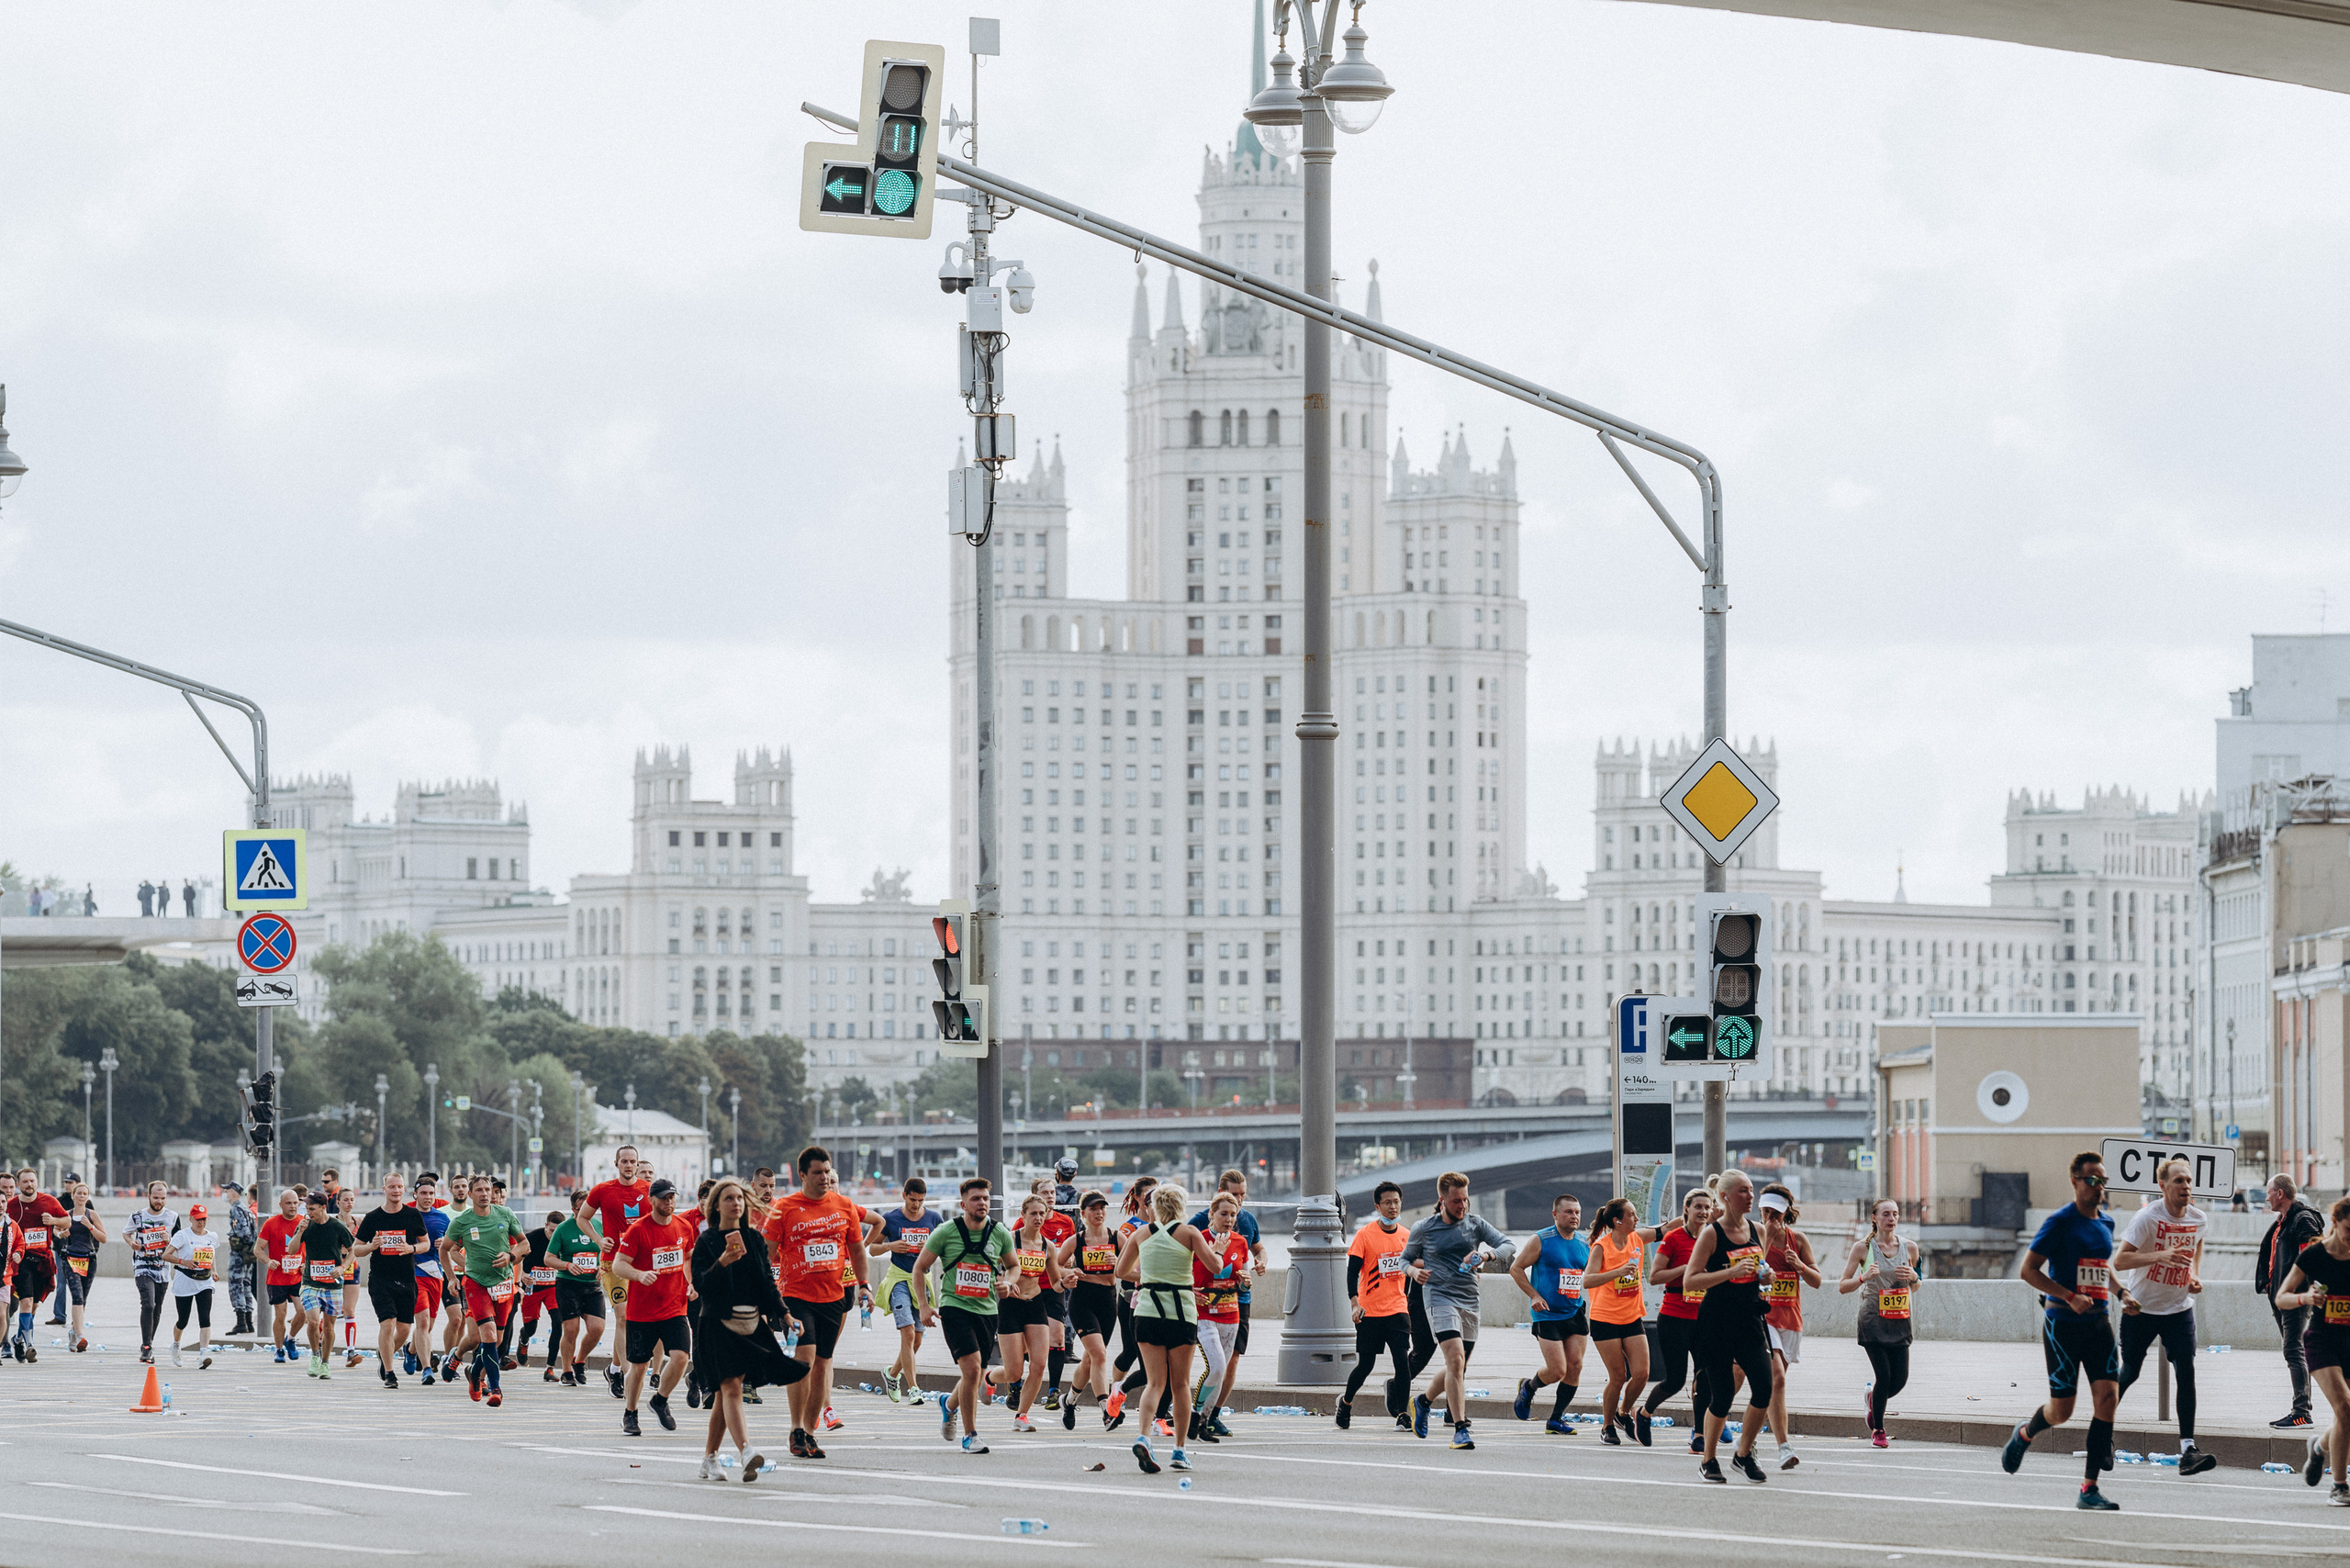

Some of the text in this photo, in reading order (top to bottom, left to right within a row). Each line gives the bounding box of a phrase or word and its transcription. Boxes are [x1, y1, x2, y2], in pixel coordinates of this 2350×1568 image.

[893, 123, 917, 154] 11
[1633, 1075, 1649, 1084] 140
[2121, 1148, 2216, 1189] СТП
[28, 1232, 45, 1240] 6682
[383, 1237, 403, 1245] 5288
[903, 1234, 928, 1242] 10870
[195, 1252, 214, 1260] 11743
[809, 1244, 834, 1257] 5843
[1087, 1251, 1105, 1261] 997
[577, 1258, 594, 1266] 3014
[657, 1251, 679, 1264] 2881
[1018, 1256, 1045, 1268] 10220
[1382, 1258, 1400, 1269] 924
[312, 1266, 334, 1274] 1035
[533, 1271, 554, 1279] 10351
[2146, 1263, 2165, 1282] НЕ
[958, 1271, 990, 1283] 10803
[490, 1282, 512, 1294] 13278
[1772, 1281, 1795, 1292] 379
[1884, 1296, 1908, 1305] 8197
[2329, 1302, 2350, 1314] 103
